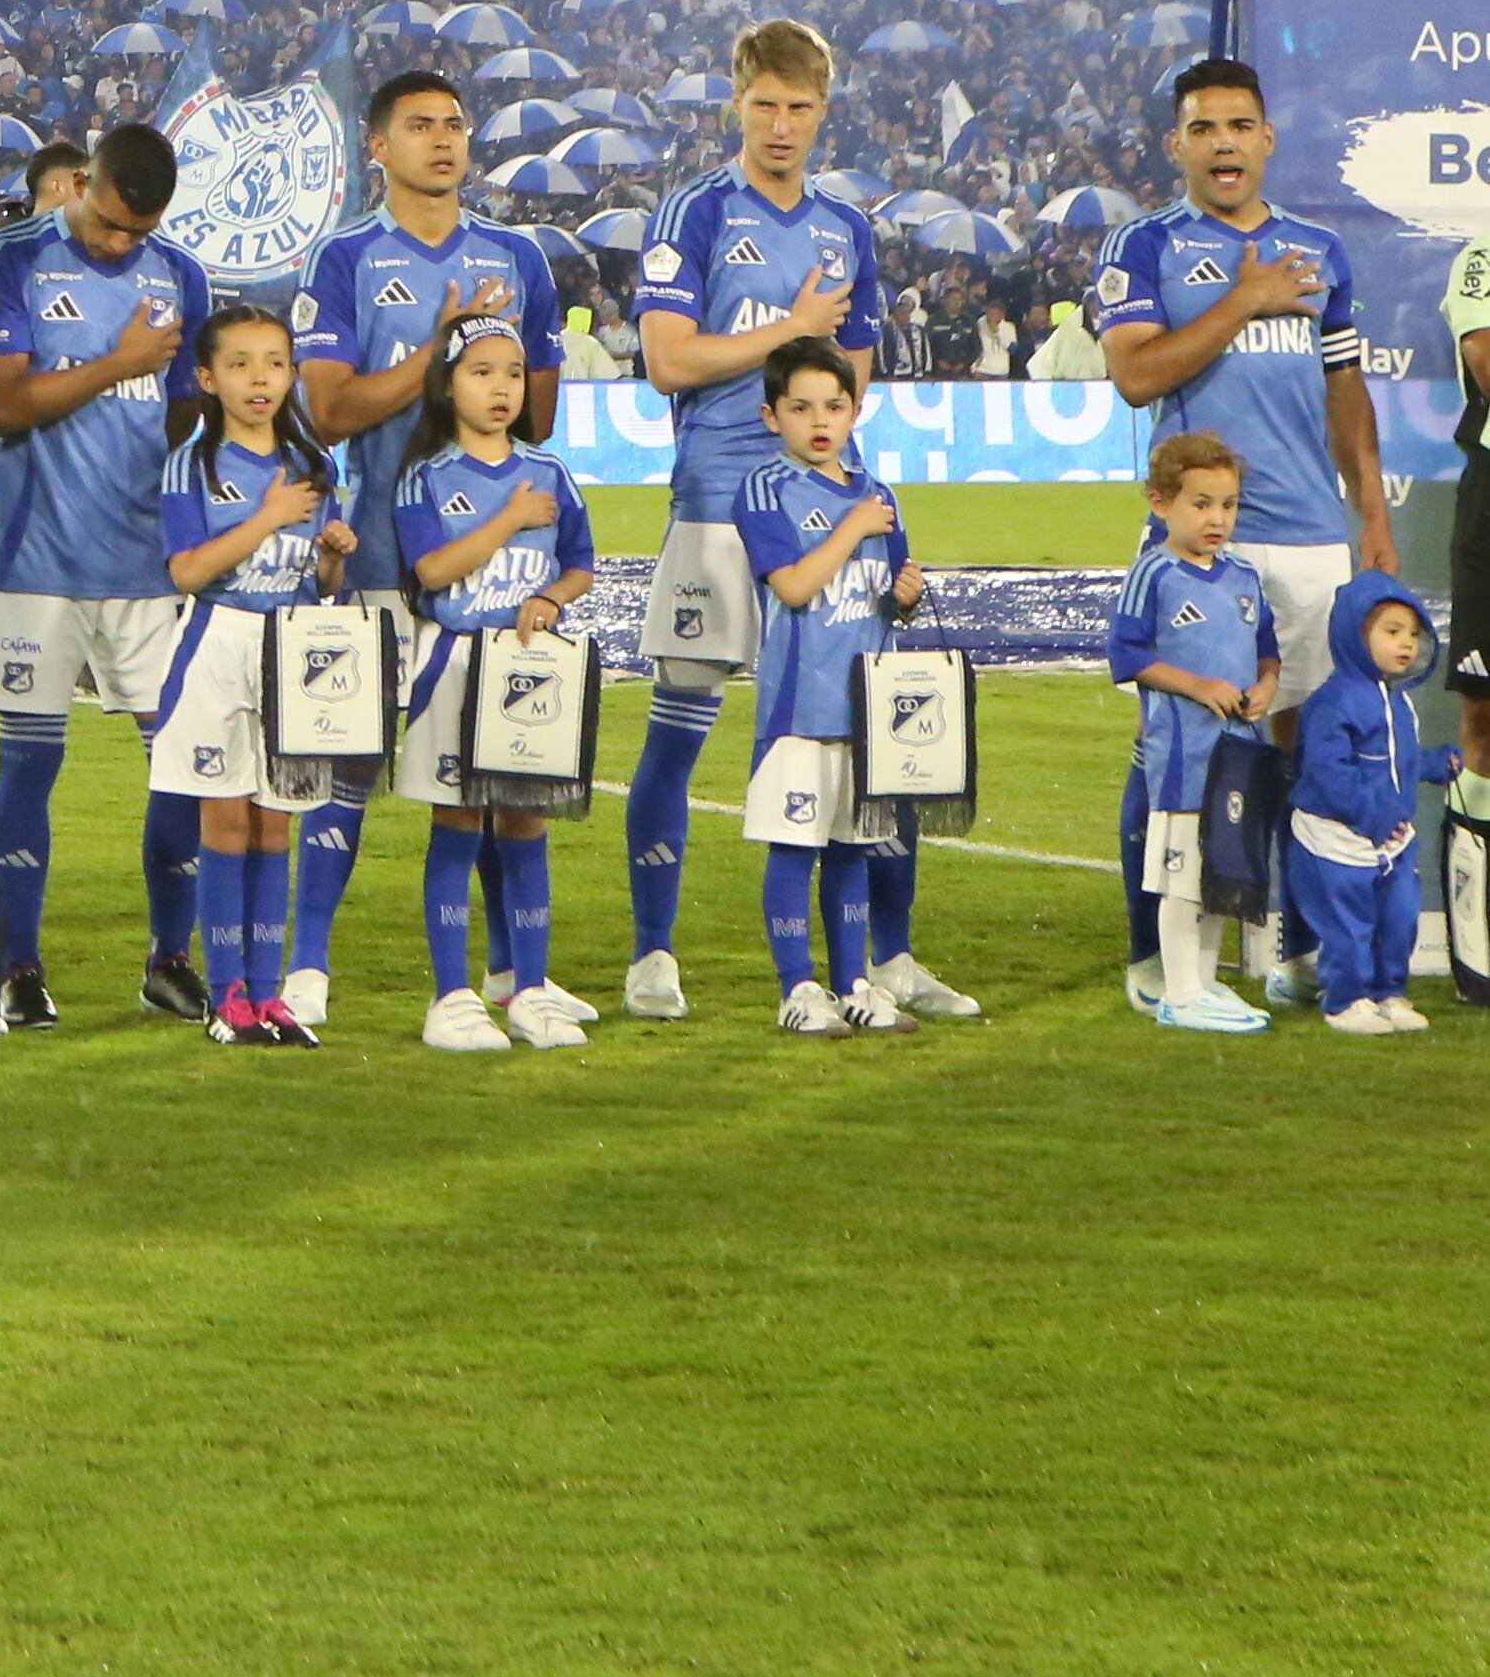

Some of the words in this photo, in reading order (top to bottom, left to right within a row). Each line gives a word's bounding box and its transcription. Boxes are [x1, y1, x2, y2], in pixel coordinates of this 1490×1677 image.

[209, 100, 249, 142] MI
[169, 208, 216, 250] ES
[221, 214, 314, 265] AZUL
[1221, 316, 1314, 355] NDINA
[1362, 337, 1414, 380] lay
[236, 533, 319, 574] ATU
